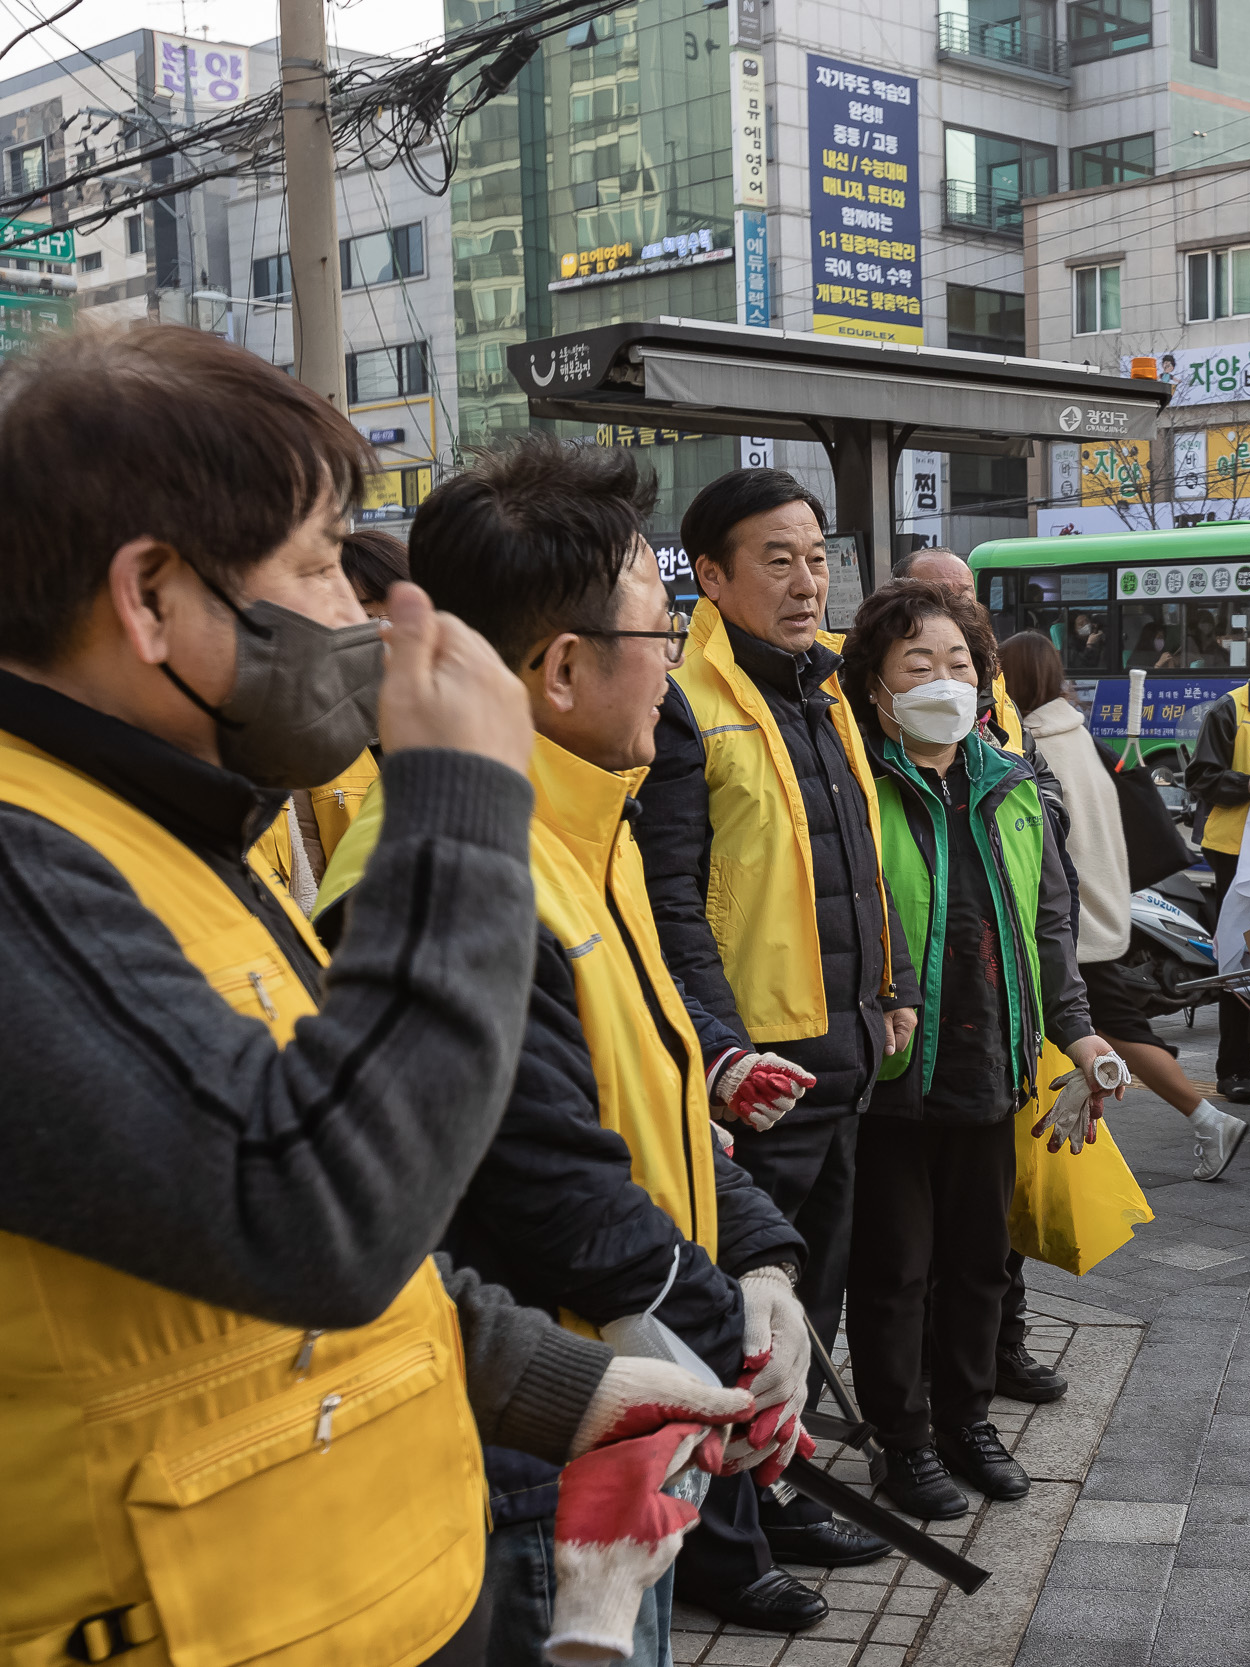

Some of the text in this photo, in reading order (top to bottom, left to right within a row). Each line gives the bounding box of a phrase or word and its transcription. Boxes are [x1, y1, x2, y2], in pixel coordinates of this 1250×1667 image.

[162, 42, 242, 101] 분양
[816, 66, 911, 105] 자기주도 학습의
[848, 100, 883, 124] 완성!!
[744, 98, 763, 194] 뮤엠영어
[833, 124, 860, 147] 중등
[872, 132, 898, 154] 고등
[822, 148, 848, 171] 내신
[860, 157, 907, 183] 수능대비
[822, 176, 905, 208] 매니저, 튜터와
[841, 206, 893, 232] 함께하는
[819, 230, 915, 262] 1:1 집중학습관리
[746, 238, 766, 324] 에듀플렉스
[825, 257, 912, 288] 국어, 영어, 수학
[816, 283, 920, 315] 개별지도 맞춤학습
[838, 326, 895, 340] EDUPLEX
[1189, 356, 1240, 392] 자양
[1085, 425, 1128, 434] GWANGJIN-GU
[1086, 410, 1128, 425] 광진구
[1093, 447, 1141, 498] 자양
[914, 473, 937, 509] 찜
[1100, 704, 1123, 721] 무릎
[1141, 704, 1154, 721] 깨
[1161, 704, 1186, 721] 허리
[1147, 895, 1180, 916] SUZUKI
